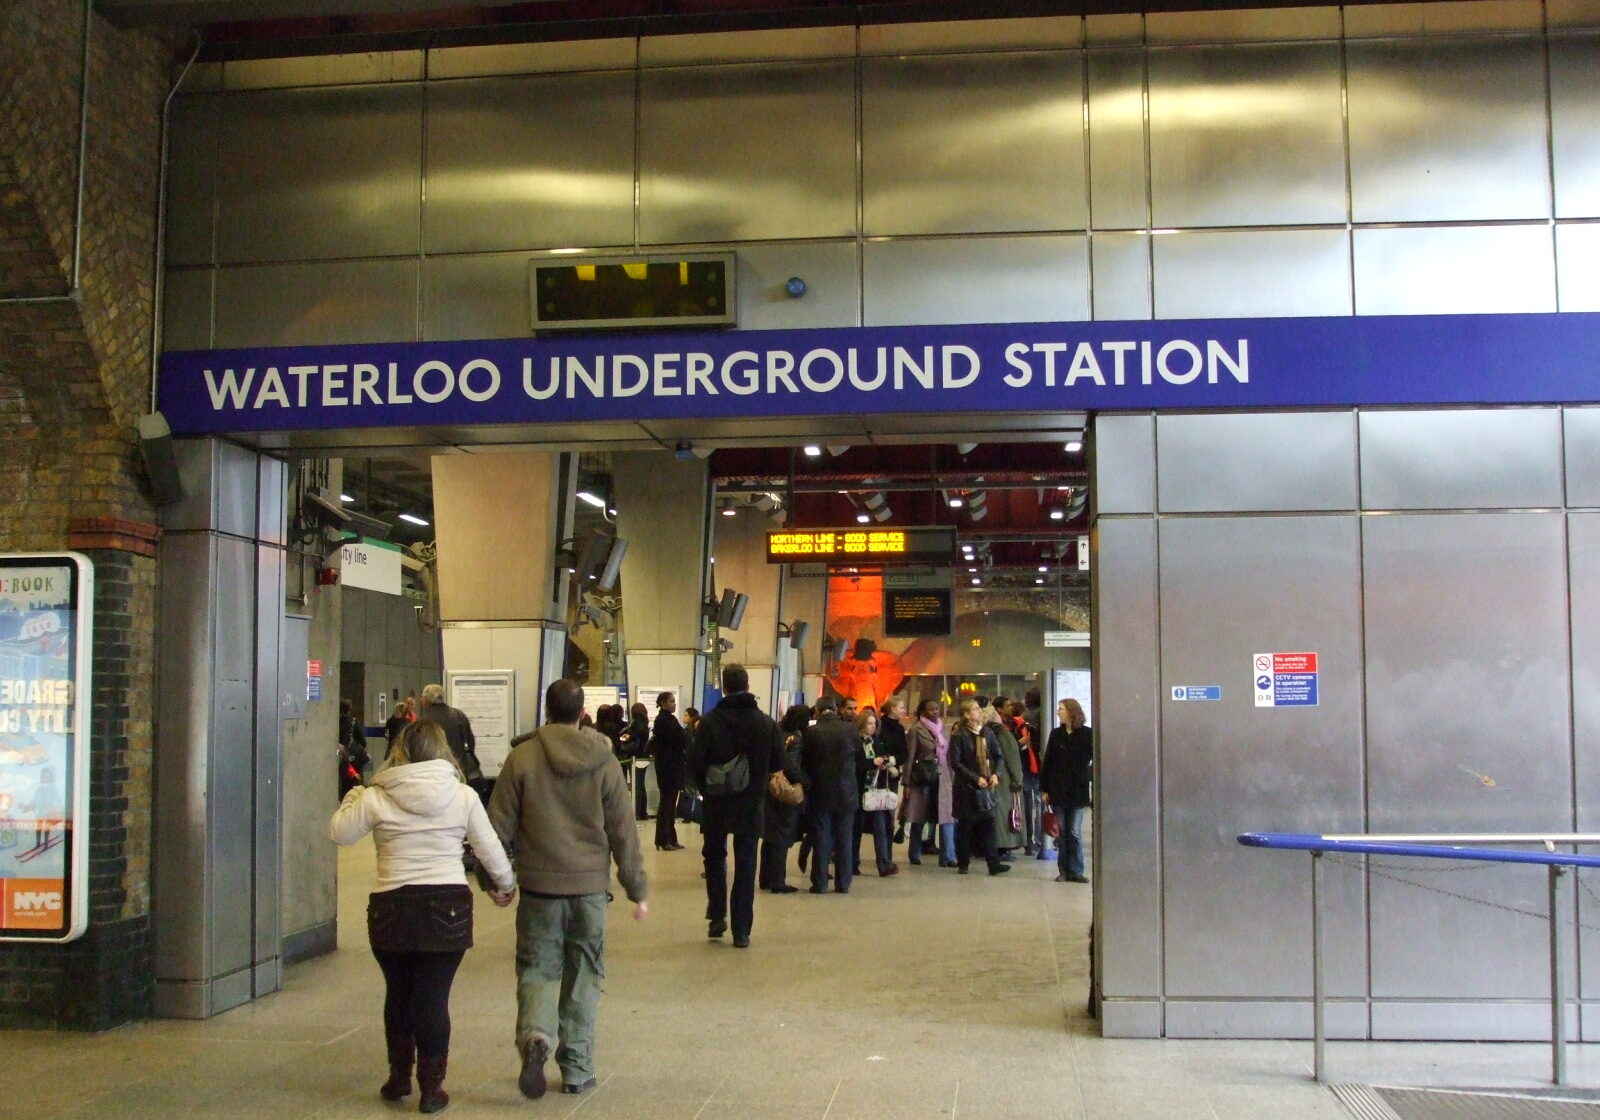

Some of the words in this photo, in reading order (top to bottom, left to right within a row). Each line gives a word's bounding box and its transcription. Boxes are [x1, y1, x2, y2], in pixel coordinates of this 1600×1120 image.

[203, 358, 501, 410] WATERLOO
[522, 344, 981, 399] UNDERGROUND
[1003, 339, 1250, 388] STATION
[770, 534, 813, 543] NORTHERN
[815, 533, 835, 543] LINE
[845, 533, 866, 542] GOOD
[869, 532, 904, 542] SERVICE
[341, 547, 353, 566] ity
[355, 547, 367, 565] line
[770, 544, 813, 553] BAKERLOO
[814, 543, 835, 553] LINE
[845, 543, 866, 552] GOOD
[869, 542, 904, 552] SERVICE
[12, 576, 55, 593] BOOK
[14, 891, 62, 911] NYC
